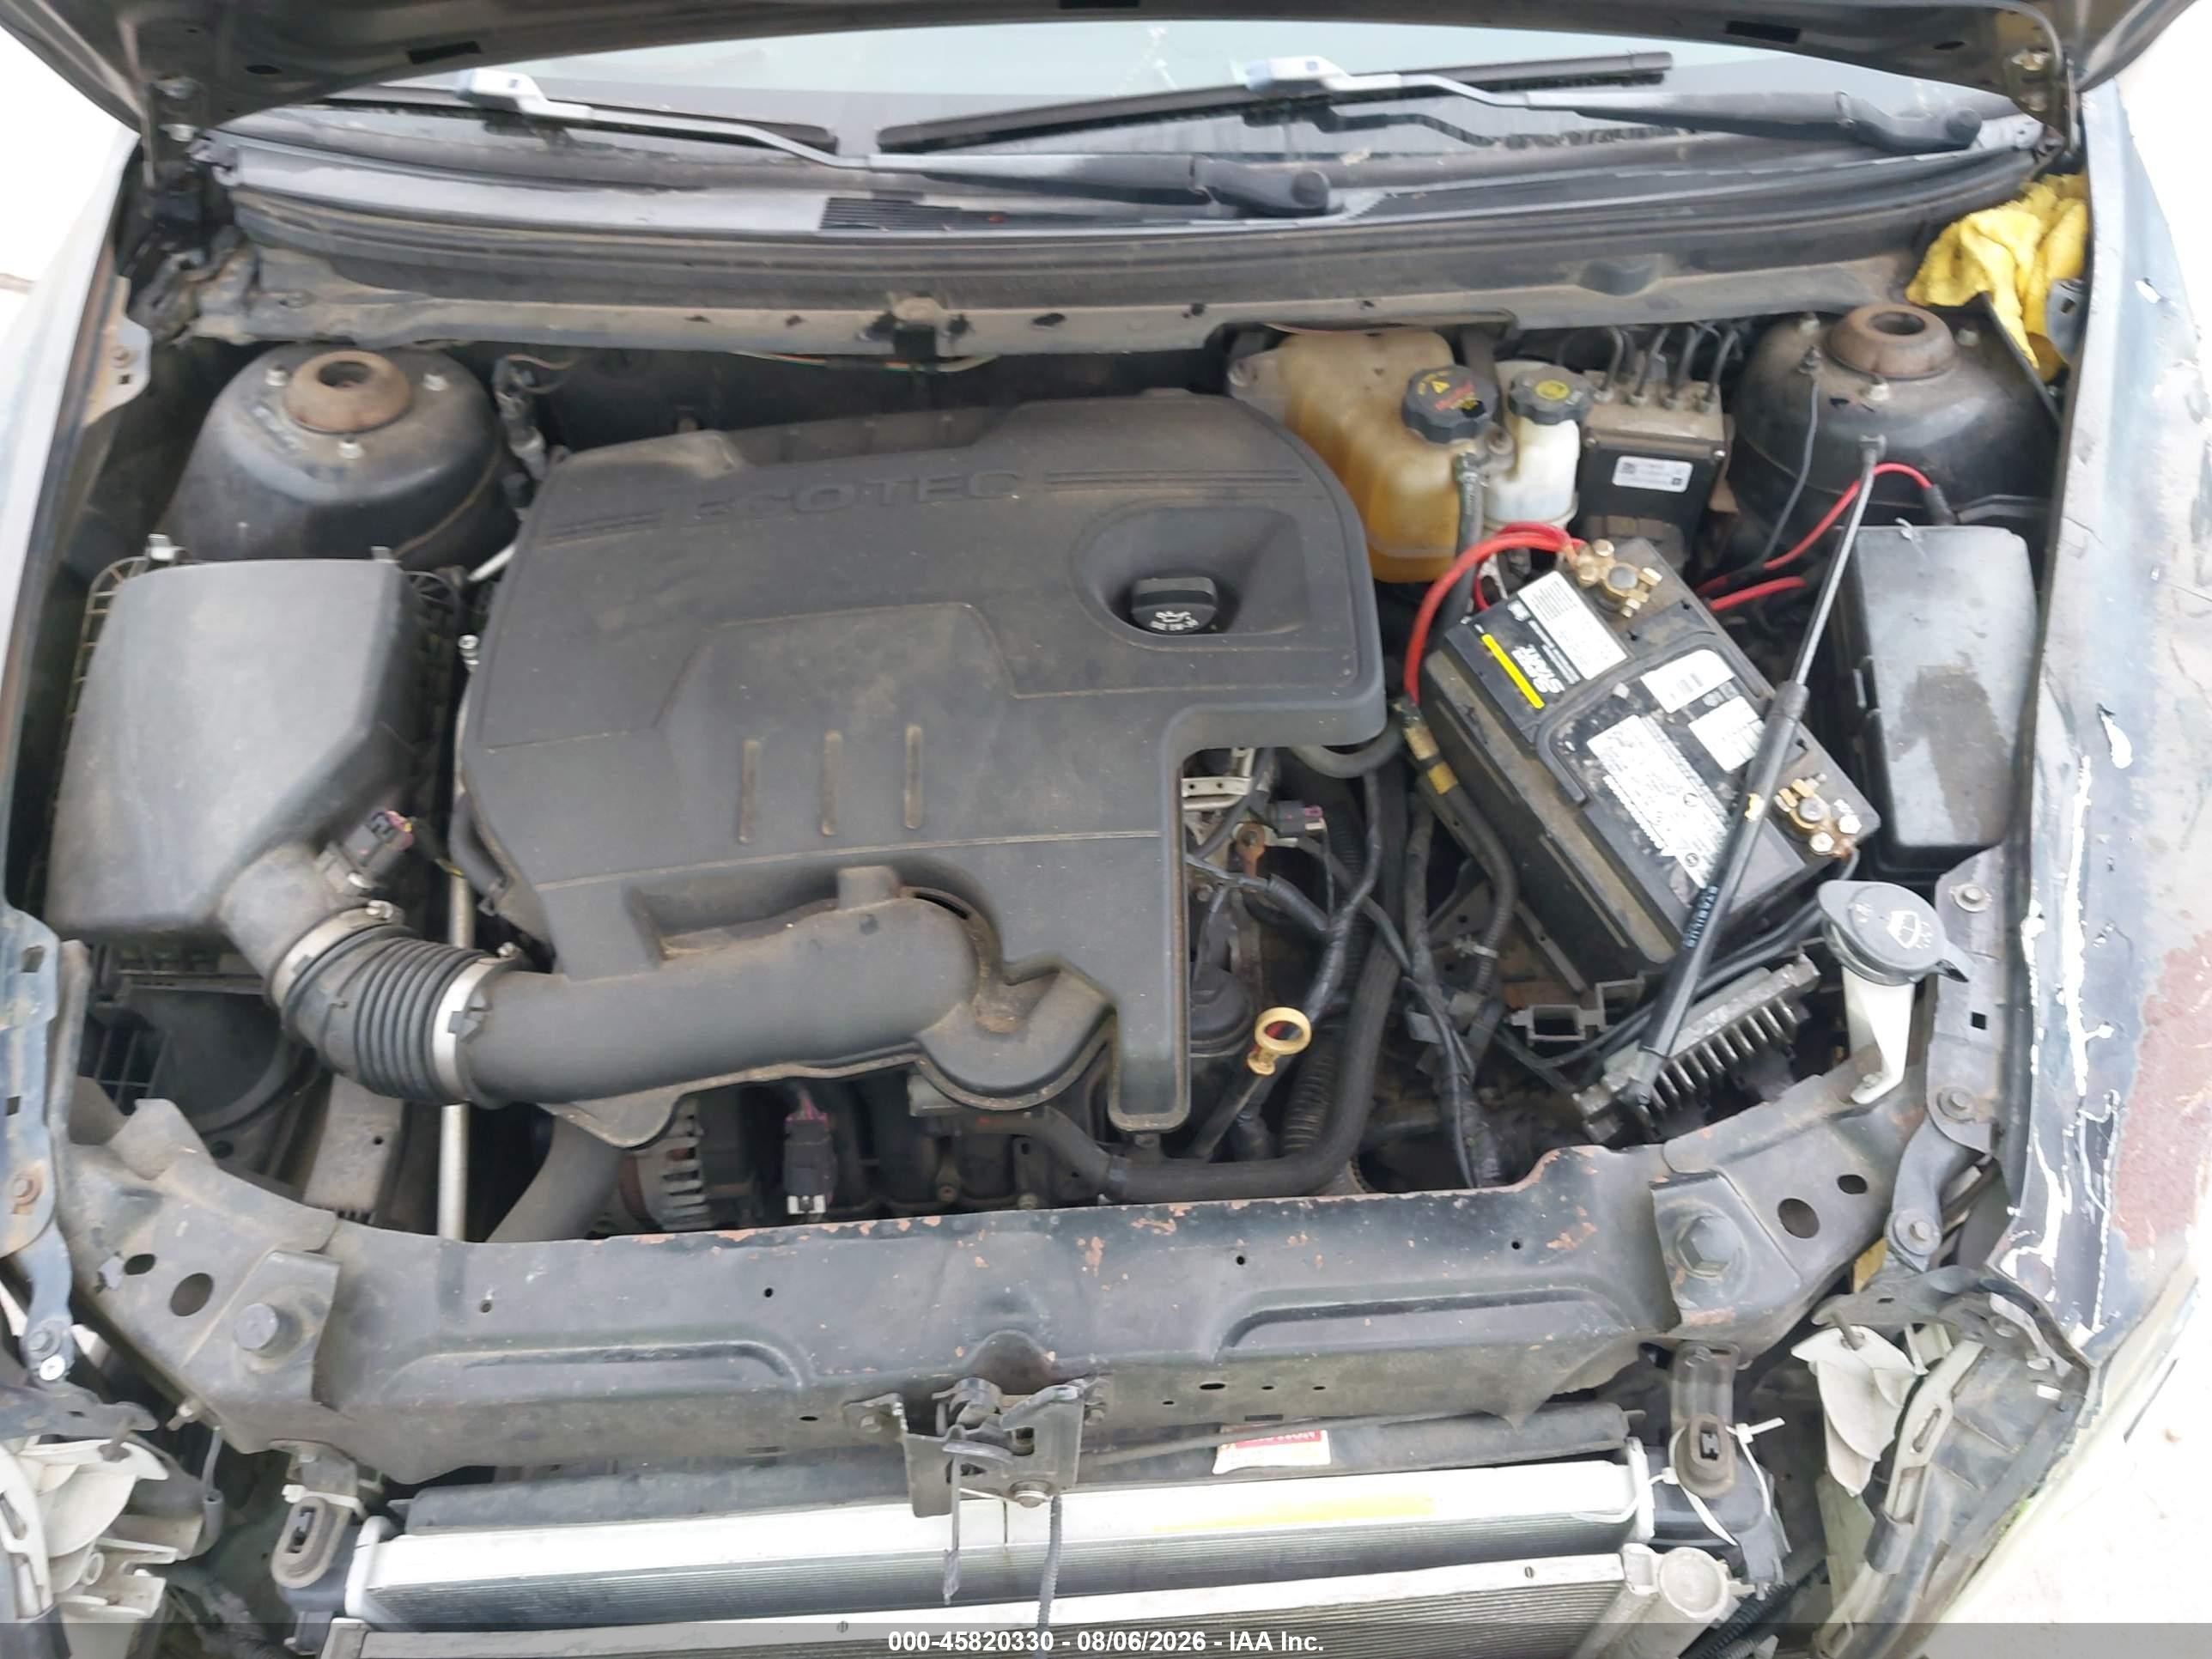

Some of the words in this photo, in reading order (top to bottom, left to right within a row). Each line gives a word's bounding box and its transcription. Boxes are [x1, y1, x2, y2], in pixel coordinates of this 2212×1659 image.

[695, 469, 1024, 517] ECOTEC
[1516, 644, 1565, 694] START
[1683, 885, 1718, 949] STABILUS
